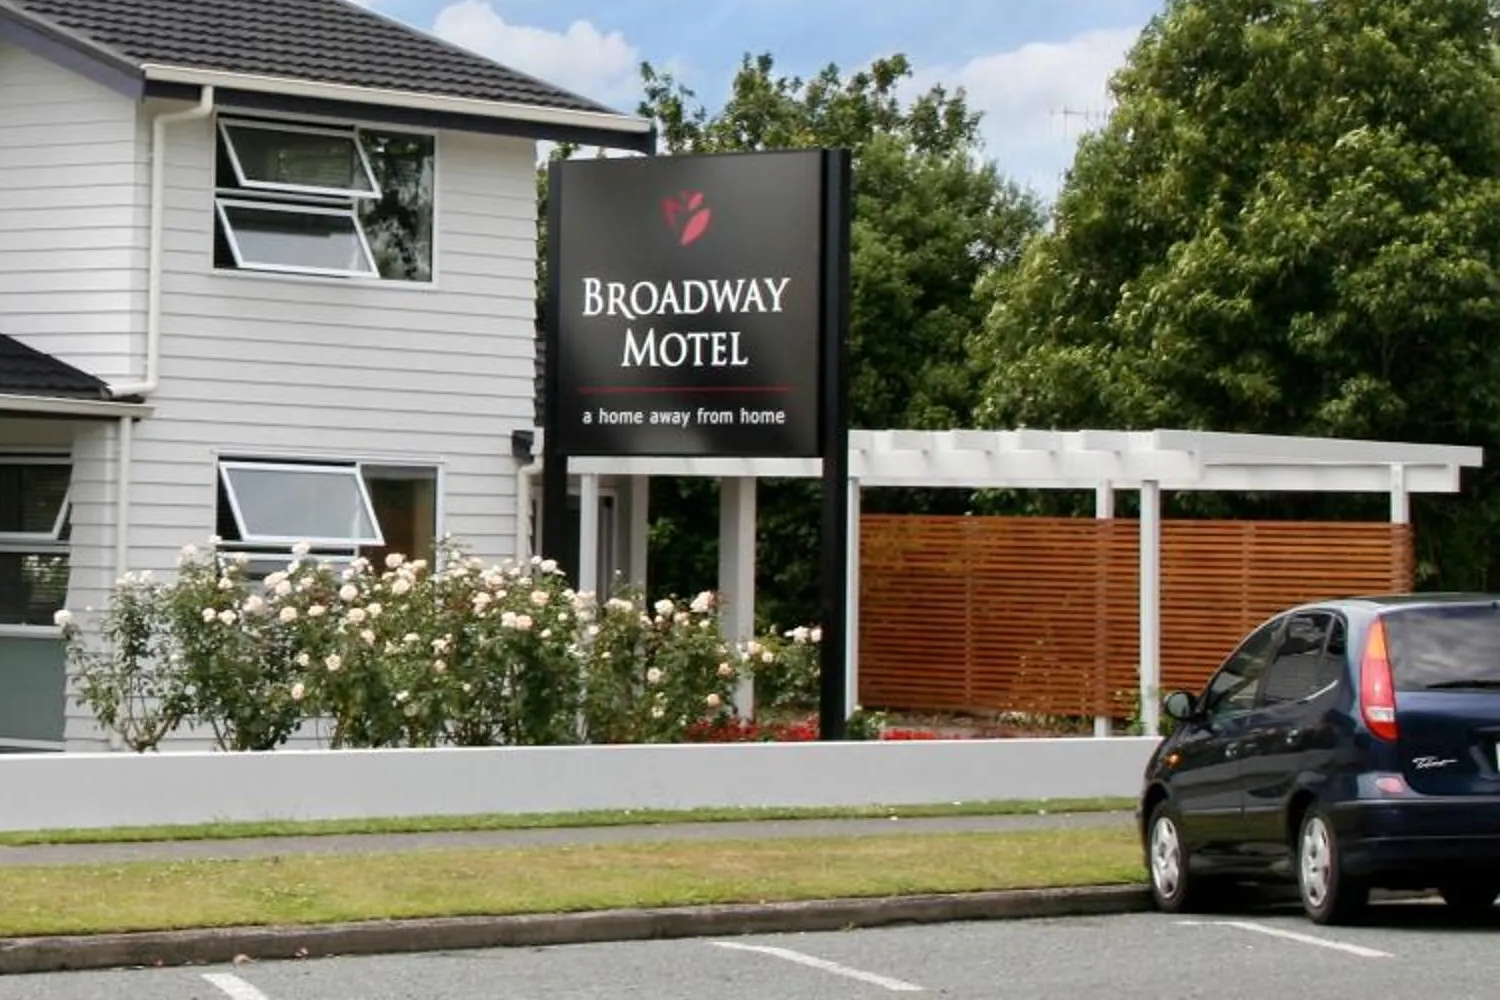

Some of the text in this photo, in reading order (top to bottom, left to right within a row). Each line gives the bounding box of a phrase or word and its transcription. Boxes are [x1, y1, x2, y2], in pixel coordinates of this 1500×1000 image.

[581, 277, 791, 320] BROADWAY
[620, 327, 749, 367] MOTEL
[582, 407, 786, 428] a home away from home
